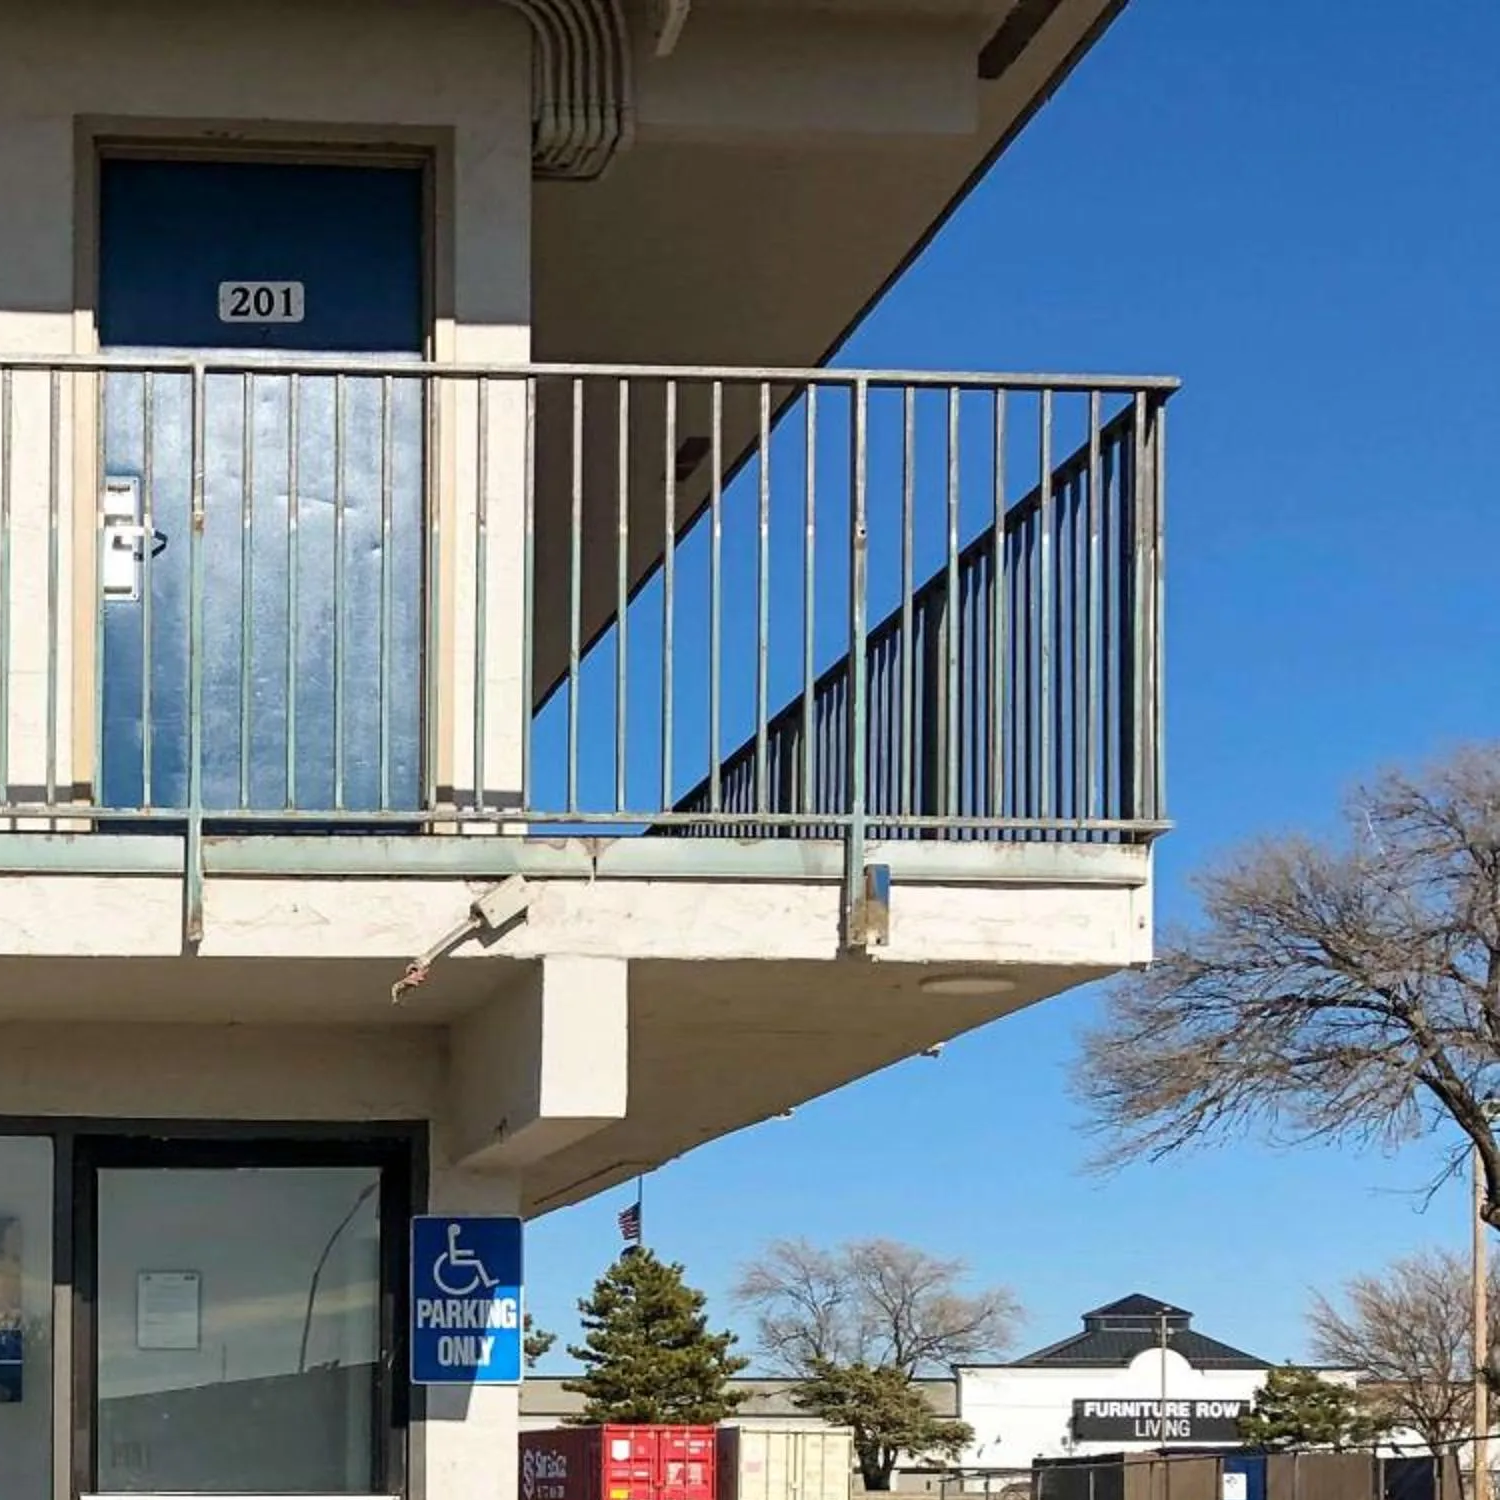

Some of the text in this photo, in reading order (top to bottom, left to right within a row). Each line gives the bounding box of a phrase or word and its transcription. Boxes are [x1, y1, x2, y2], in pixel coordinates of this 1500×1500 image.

[230, 286, 293, 317] 201
[417, 1298, 517, 1329] PARKING
[437, 1335, 495, 1367] ONLY
[1083, 1401, 1241, 1418] FURNITURE ROW
[1135, 1419, 1191, 1438] LIVNG
